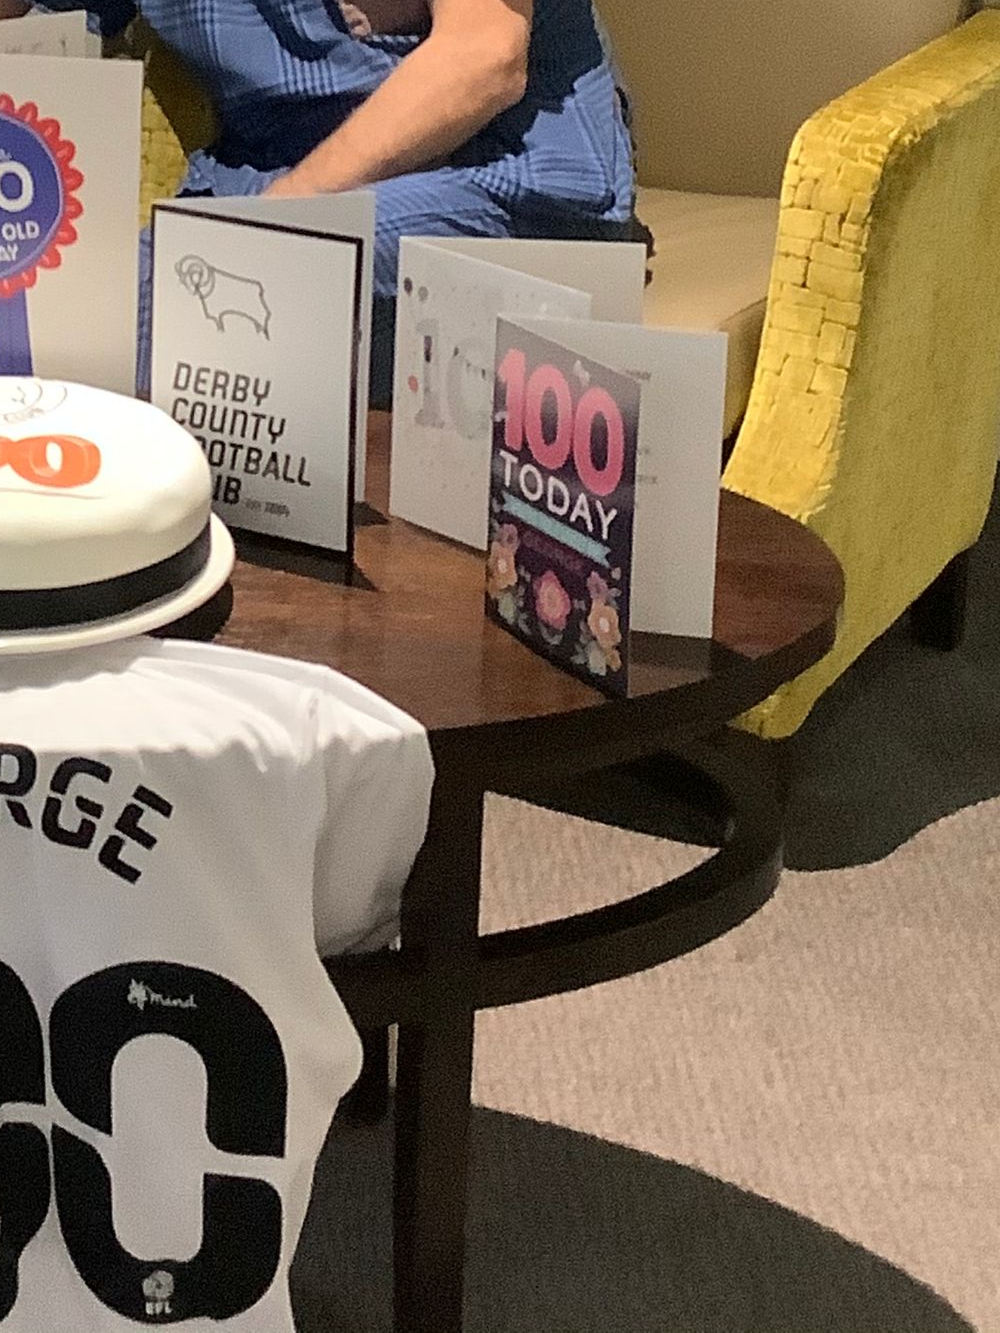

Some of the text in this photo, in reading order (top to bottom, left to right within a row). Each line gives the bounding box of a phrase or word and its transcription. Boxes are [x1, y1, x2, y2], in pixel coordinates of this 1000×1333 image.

[1, 220, 40, 241] OLD
[173, 361, 271, 407] DERBY
[172, 397, 286, 445] COUNTY
[496, 347, 625, 497] 100
[194, 435, 311, 488] OTBALL
[499, 449, 618, 540] TODAY
